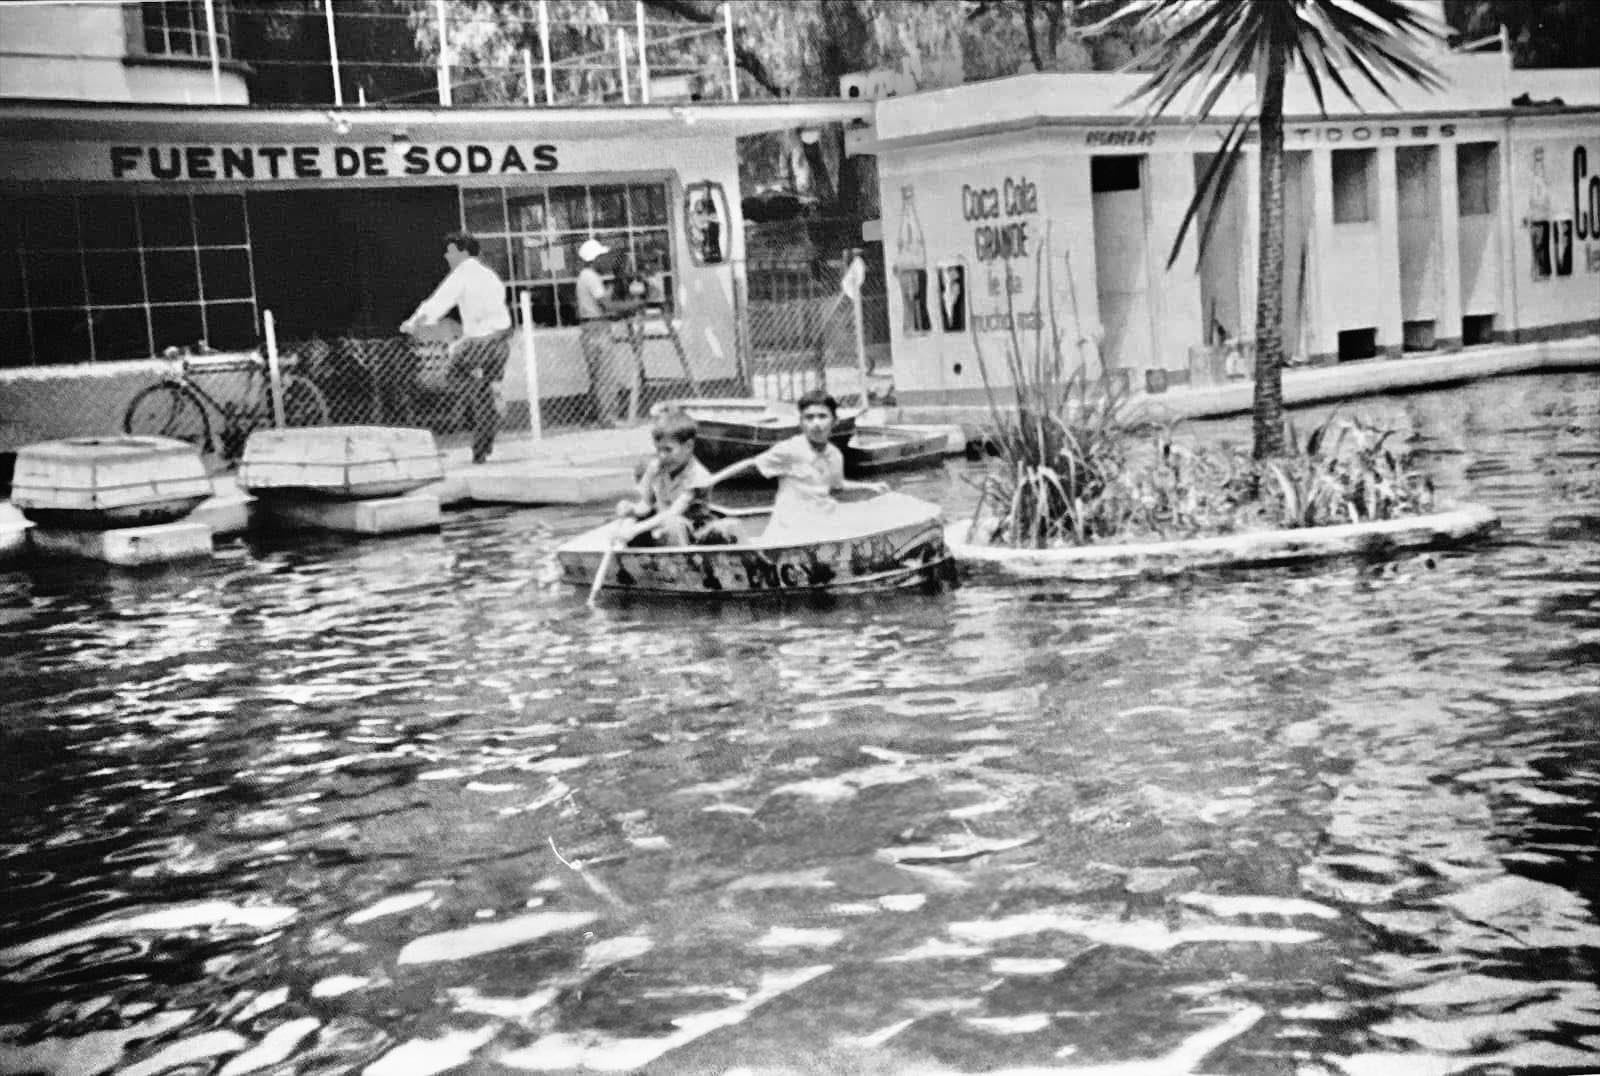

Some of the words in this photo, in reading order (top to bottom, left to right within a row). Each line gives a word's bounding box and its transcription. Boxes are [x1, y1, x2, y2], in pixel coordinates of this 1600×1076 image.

[110, 147, 322, 179] FUENTE
[335, 146, 389, 177] DE
[404, 144, 559, 175] SODAS
[962, 184, 999, 221] Coca
[1003, 176, 1038, 216] Cola
[975, 221, 1028, 262] GRANDE
